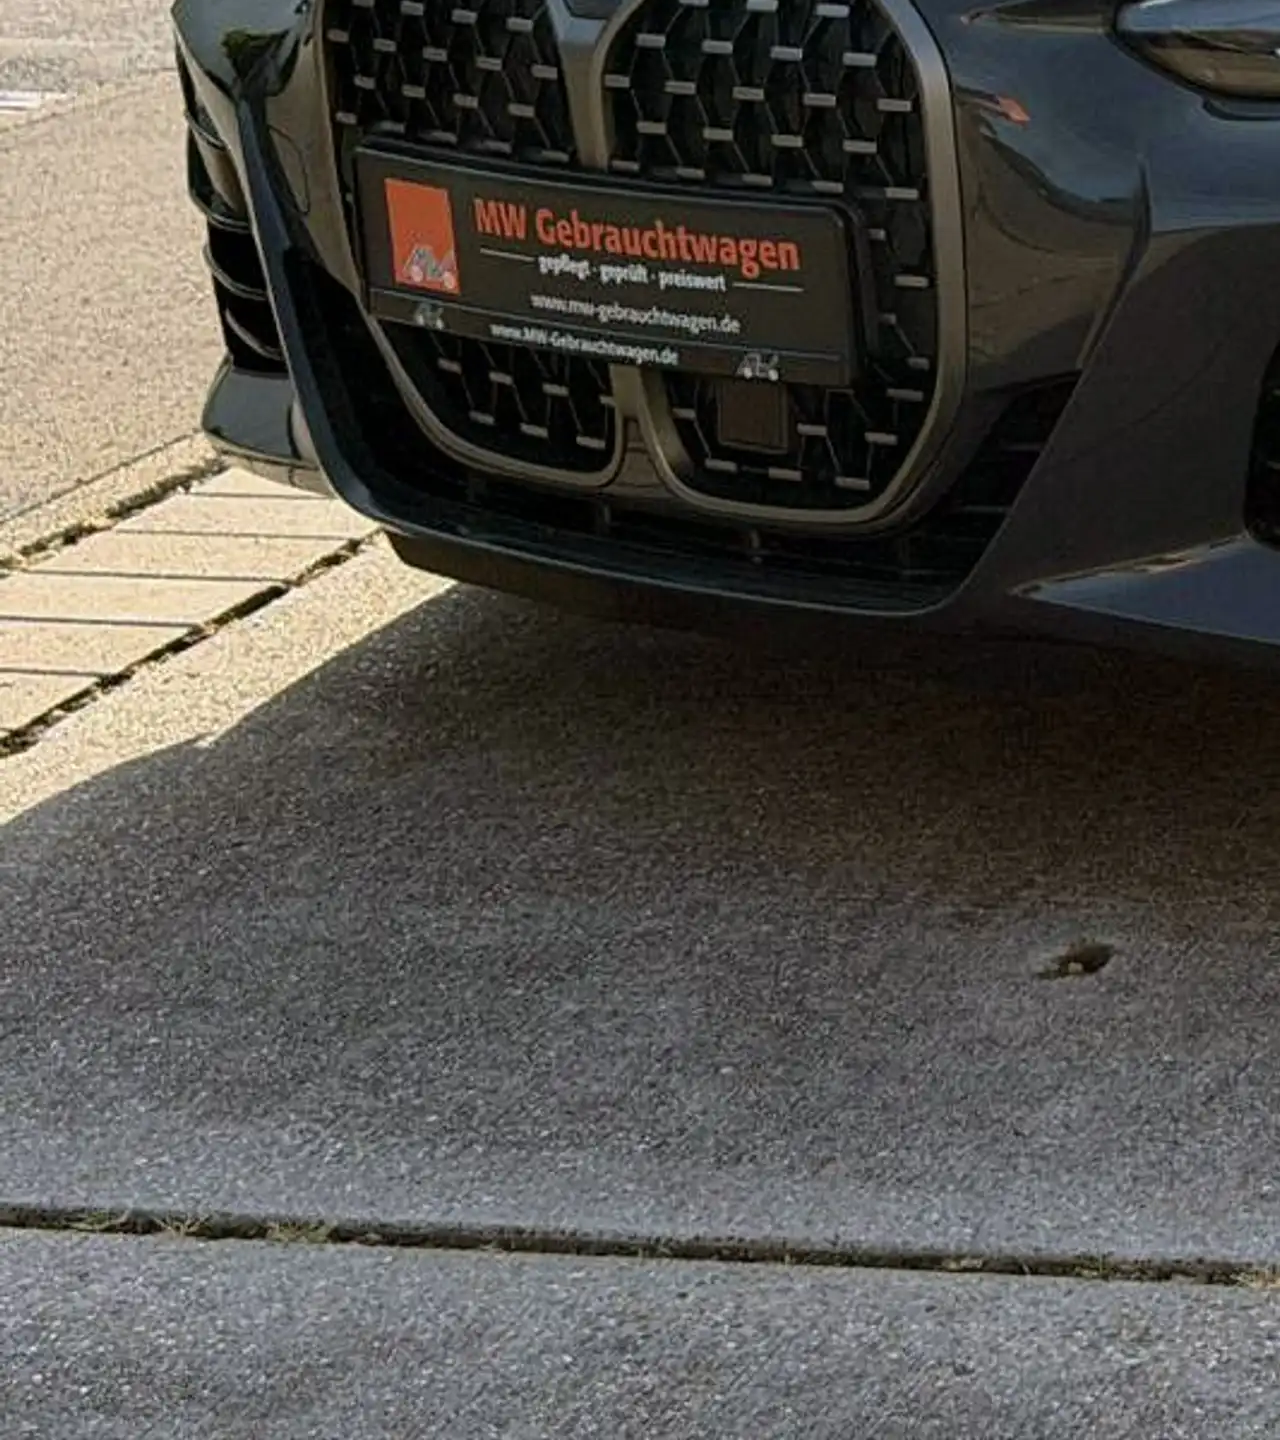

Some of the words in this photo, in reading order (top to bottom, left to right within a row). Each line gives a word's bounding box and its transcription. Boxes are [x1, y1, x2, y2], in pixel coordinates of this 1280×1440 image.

[473, 197, 527, 241] MW
[535, 207, 800, 279] Gebrauchtwagen
[658, 268, 727, 293] preiswert
